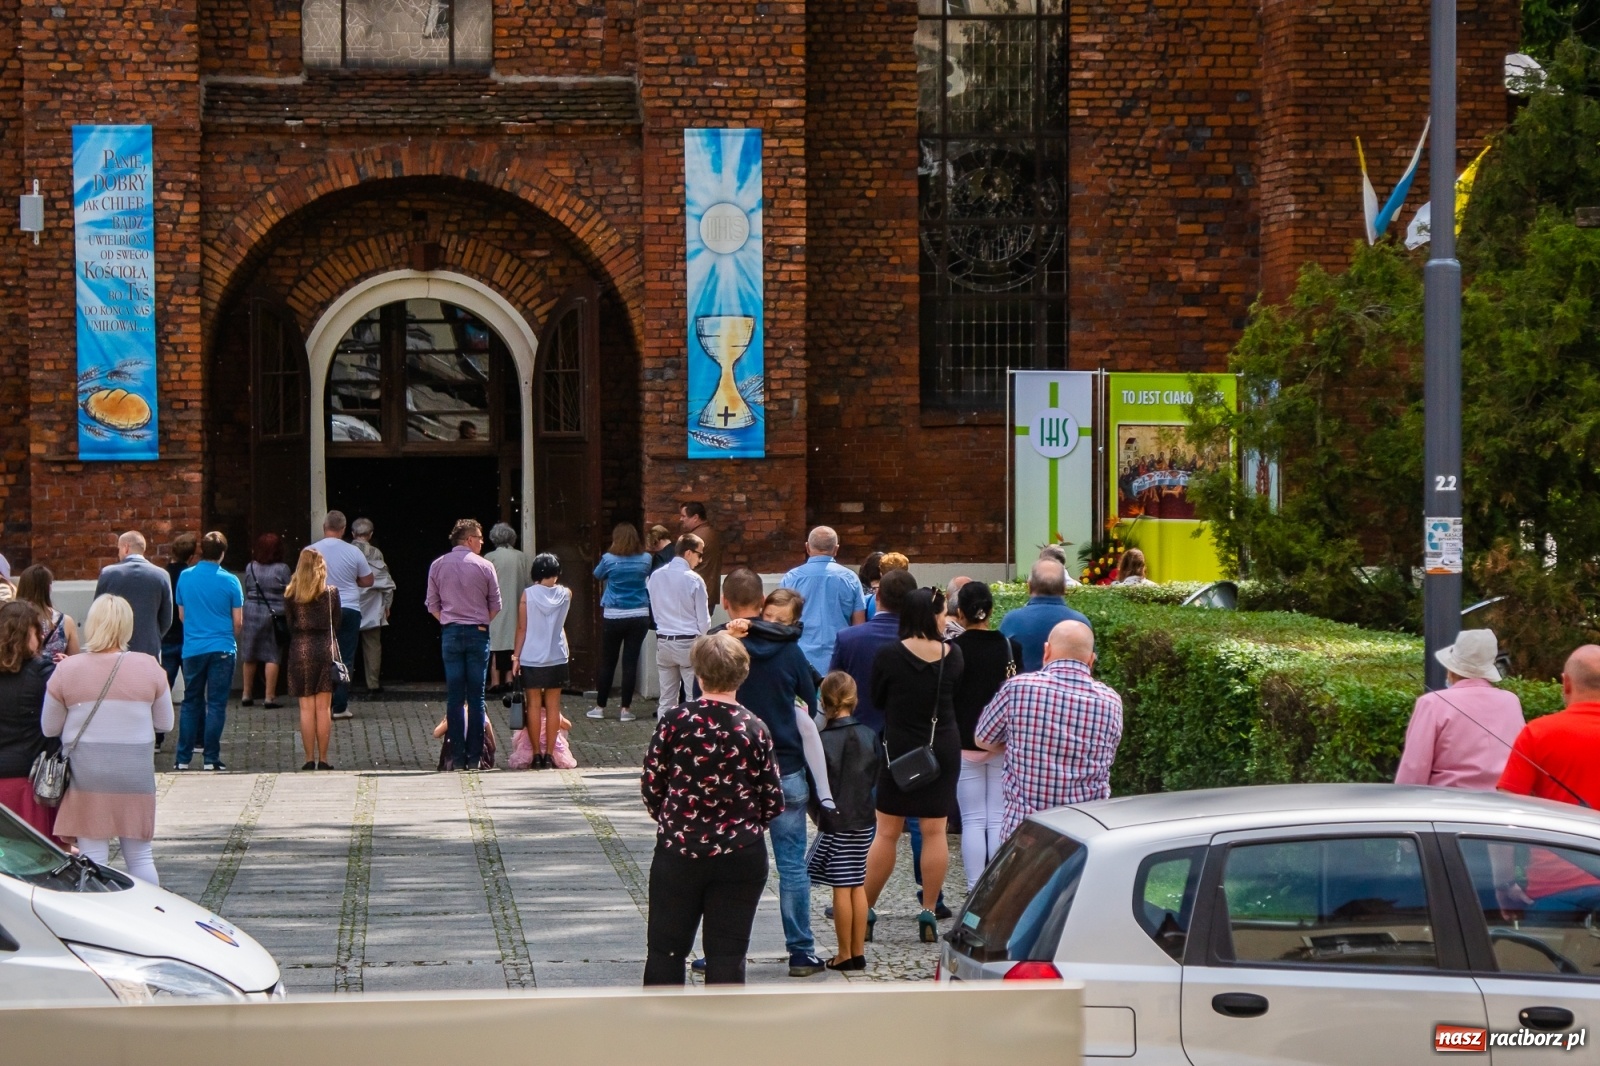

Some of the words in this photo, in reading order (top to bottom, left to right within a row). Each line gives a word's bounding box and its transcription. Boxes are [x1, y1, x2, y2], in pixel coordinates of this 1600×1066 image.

[94, 173, 148, 191] DOBRY
[83, 200, 99, 212] JAK
[88, 234, 147, 246] UWIELBIONY
[100, 249, 114, 260] OD
[116, 249, 149, 260] SWEGO
[108, 290, 123, 301] BO
[84, 305, 98, 315] DO
[133, 304, 150, 315] NAS
[1122, 390, 1136, 404] TO
[1137, 390, 1161, 405] JEST
[1163, 390, 1194, 405] CIAŁO
[1040, 417, 1070, 447] IHS
